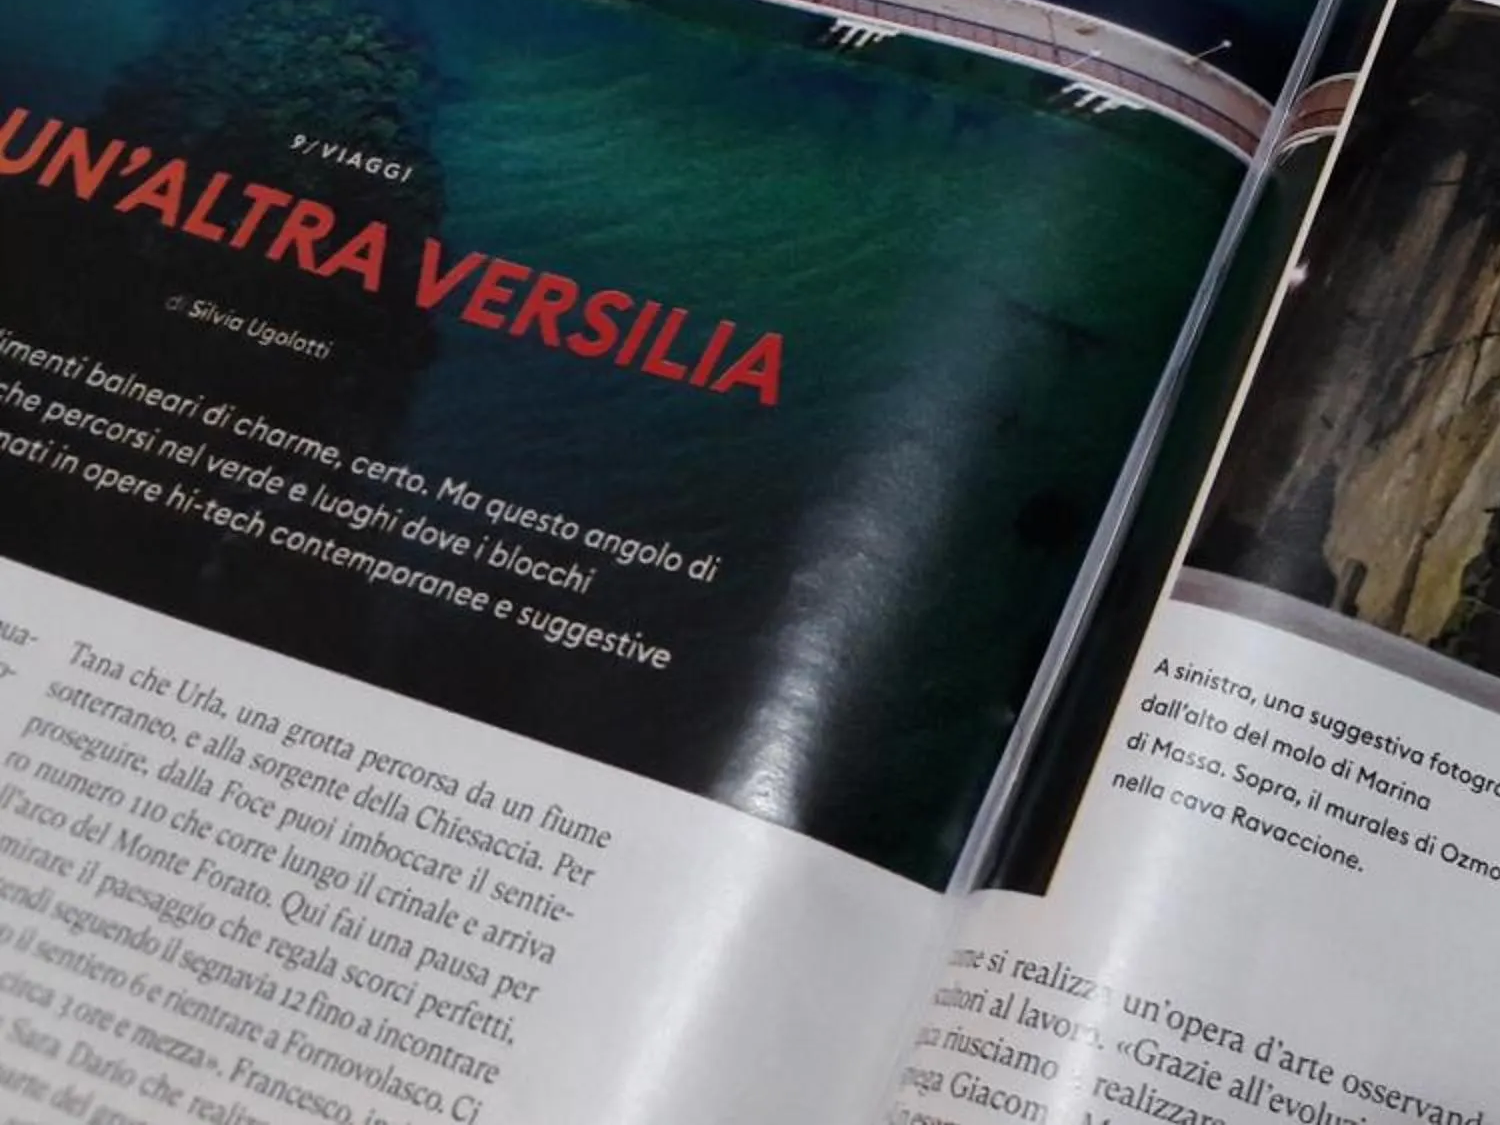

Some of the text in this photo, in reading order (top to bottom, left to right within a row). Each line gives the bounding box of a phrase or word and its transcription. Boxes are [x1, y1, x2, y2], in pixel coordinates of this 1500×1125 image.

[0, 111, 782, 405] UN'ALTRA VERSILIA
[188, 298, 245, 333] Silvia
[40, 400, 161, 451] percorsi
[156, 439, 207, 467] nel
[206, 454, 285, 495] verde
[287, 482, 308, 502] e
[310, 483, 404, 532] luoghi
[400, 515, 471, 556] dove
[473, 534, 490, 560] i
[486, 539, 593, 594] blocchi
[84, 361, 200, 417] balneari
[201, 403, 236, 428] di
[232, 415, 342, 470] charme,
[350, 455, 428, 496] certo.
[435, 476, 483, 511] Ma
[484, 497, 580, 541] questo
[583, 528, 683, 572] angolo
[687, 555, 718, 583] di
[50, 451, 79, 474] in
[81, 462, 163, 502] opere
[164, 482, 266, 538] hi-tech
[269, 525, 490, 612] contemporanee
[493, 598, 513, 619] e
[516, 606, 672, 669] suggestive
[69, 640, 125, 681] Tana
[128, 667, 172, 697] che
[235, 705, 281, 735] una
[280, 722, 355, 761] grotta
[355, 748, 460, 797] percorsa
[464, 783, 496, 810] da
[500, 797, 535, 824] un
[538, 806, 612, 849] fiume
[1139, 693, 1431, 811] dall'alto del molo di Marina
[1152, 657, 1169, 677] A
[1172, 665, 1257, 706] sinistra,
[1262, 693, 1305, 720] una
[1308, 709, 1425, 766] suggestiva
[1111, 772, 1364, 873] nella cava Ravaccione.
[1125, 730, 1149, 752] di
[1149, 735, 1226, 778] Massa.
[1232, 763, 1302, 808] Sopra,
[1306, 792, 1323, 812] il
[1323, 801, 1410, 846] murales
[1413, 833, 1435, 856] di
